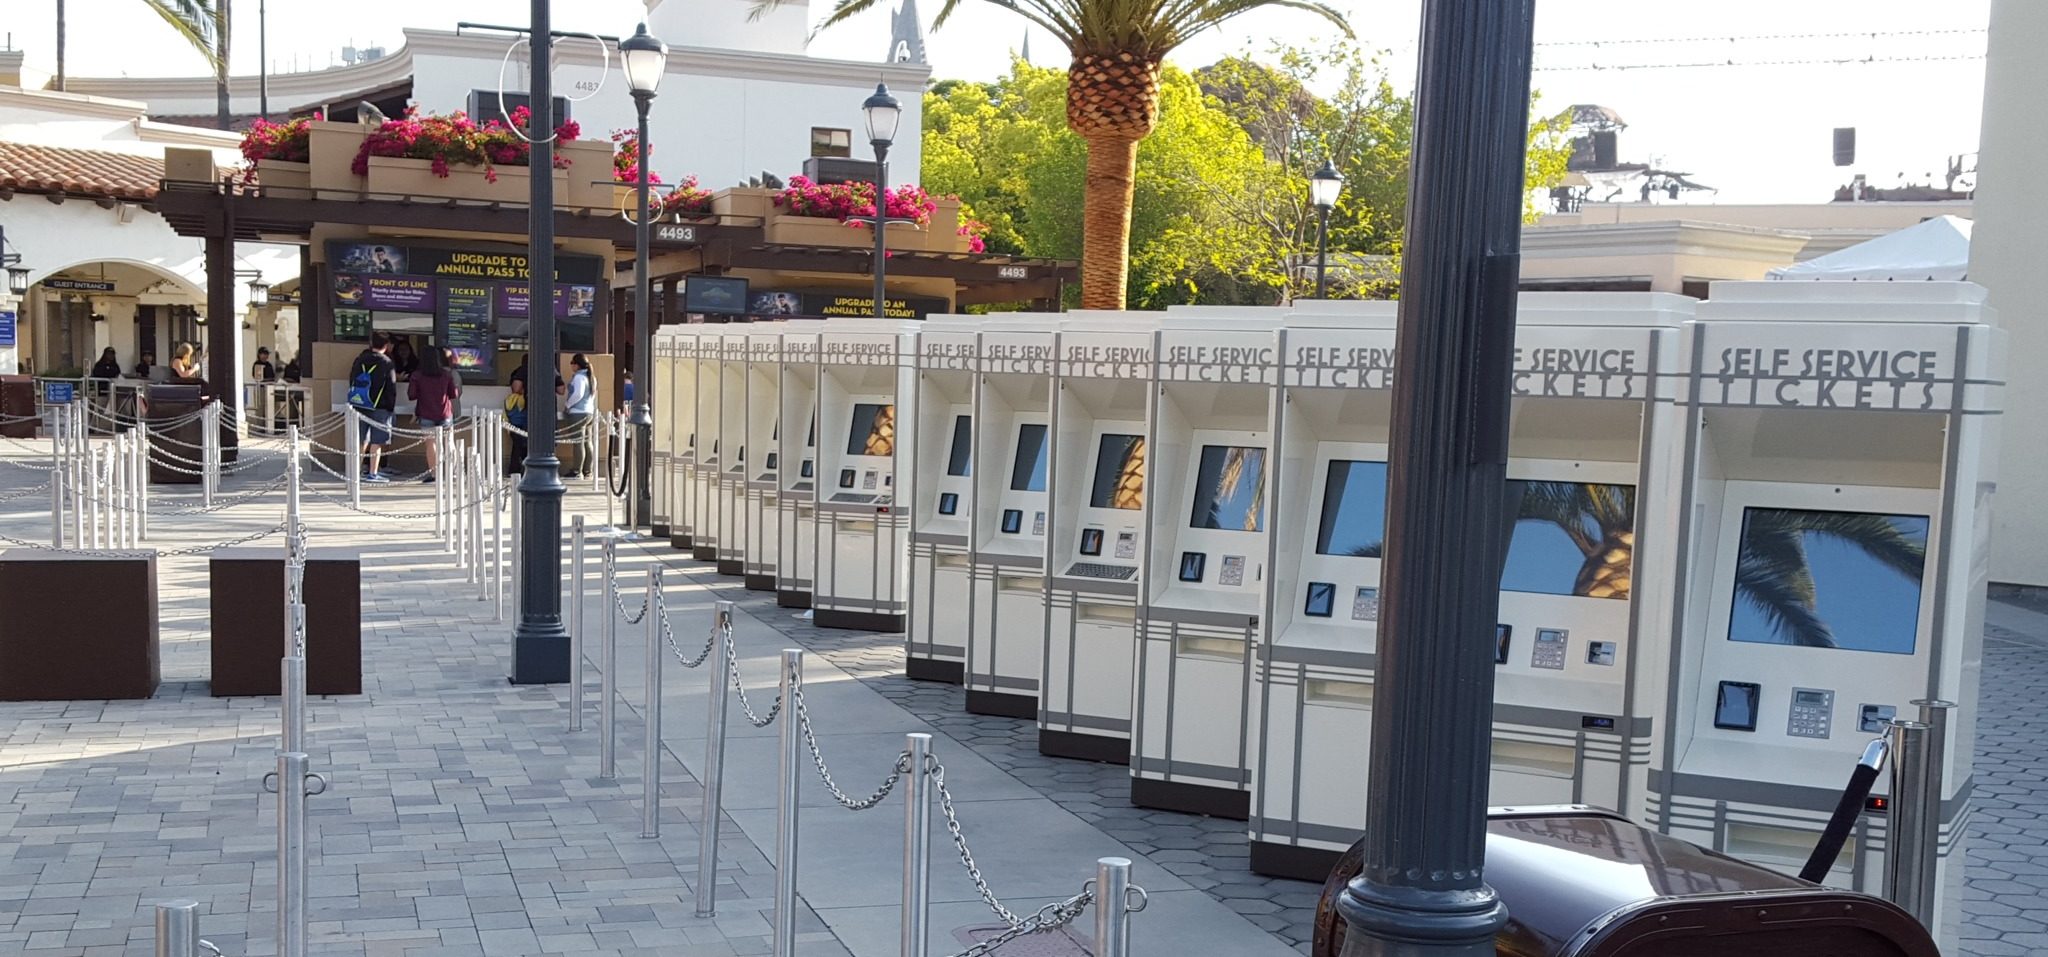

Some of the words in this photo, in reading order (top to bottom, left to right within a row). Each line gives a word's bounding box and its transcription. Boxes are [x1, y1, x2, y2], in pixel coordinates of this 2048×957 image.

[660, 227, 692, 239] 4493
[452, 253, 507, 265] UPGRADE
[510, 257, 526, 267] TO
[436, 264, 484, 275] ANNUAL
[487, 267, 515, 277] PASS
[1000, 268, 1025, 278] 4493
[369, 279, 396, 287] FRONT
[450, 287, 485, 296] TICKETS
[822, 306, 859, 315] ANNUAL
[884, 309, 915, 317] TODAY!
[753, 344, 771, 353] SELF
[788, 343, 807, 353] SELF
[827, 343, 848, 354] SELF
[852, 344, 891, 355] SERVICE
[927, 344, 952, 356] SELF
[988, 345, 1016, 358] SELF
[1020, 346, 1051, 360] SERV
[1068, 346, 1100, 361] SELF
[1105, 347, 1150, 362] SERVI
[1169, 346, 1206, 363] SELF
[1212, 347, 1272, 365] SERVIC
[827, 353, 891, 366] TICKETS
[927, 356, 971, 371] TICK
[1297, 347, 1340, 367] SELF
[1347, 348, 1395, 369] SERV
[1530, 348, 1635, 374] SERVICE
[1719, 348, 1790, 376] SELF
[1800, 349, 1936, 379] SERVICE
[988, 359, 1050, 374] TICKE
[1068, 361, 1149, 379] TICKET
[1169, 363, 1268, 384] TICKET
[1296, 366, 1393, 389] TICKE
[1513, 371, 1632, 398] CKETS
[1718, 374, 1933, 409] TICKETS
